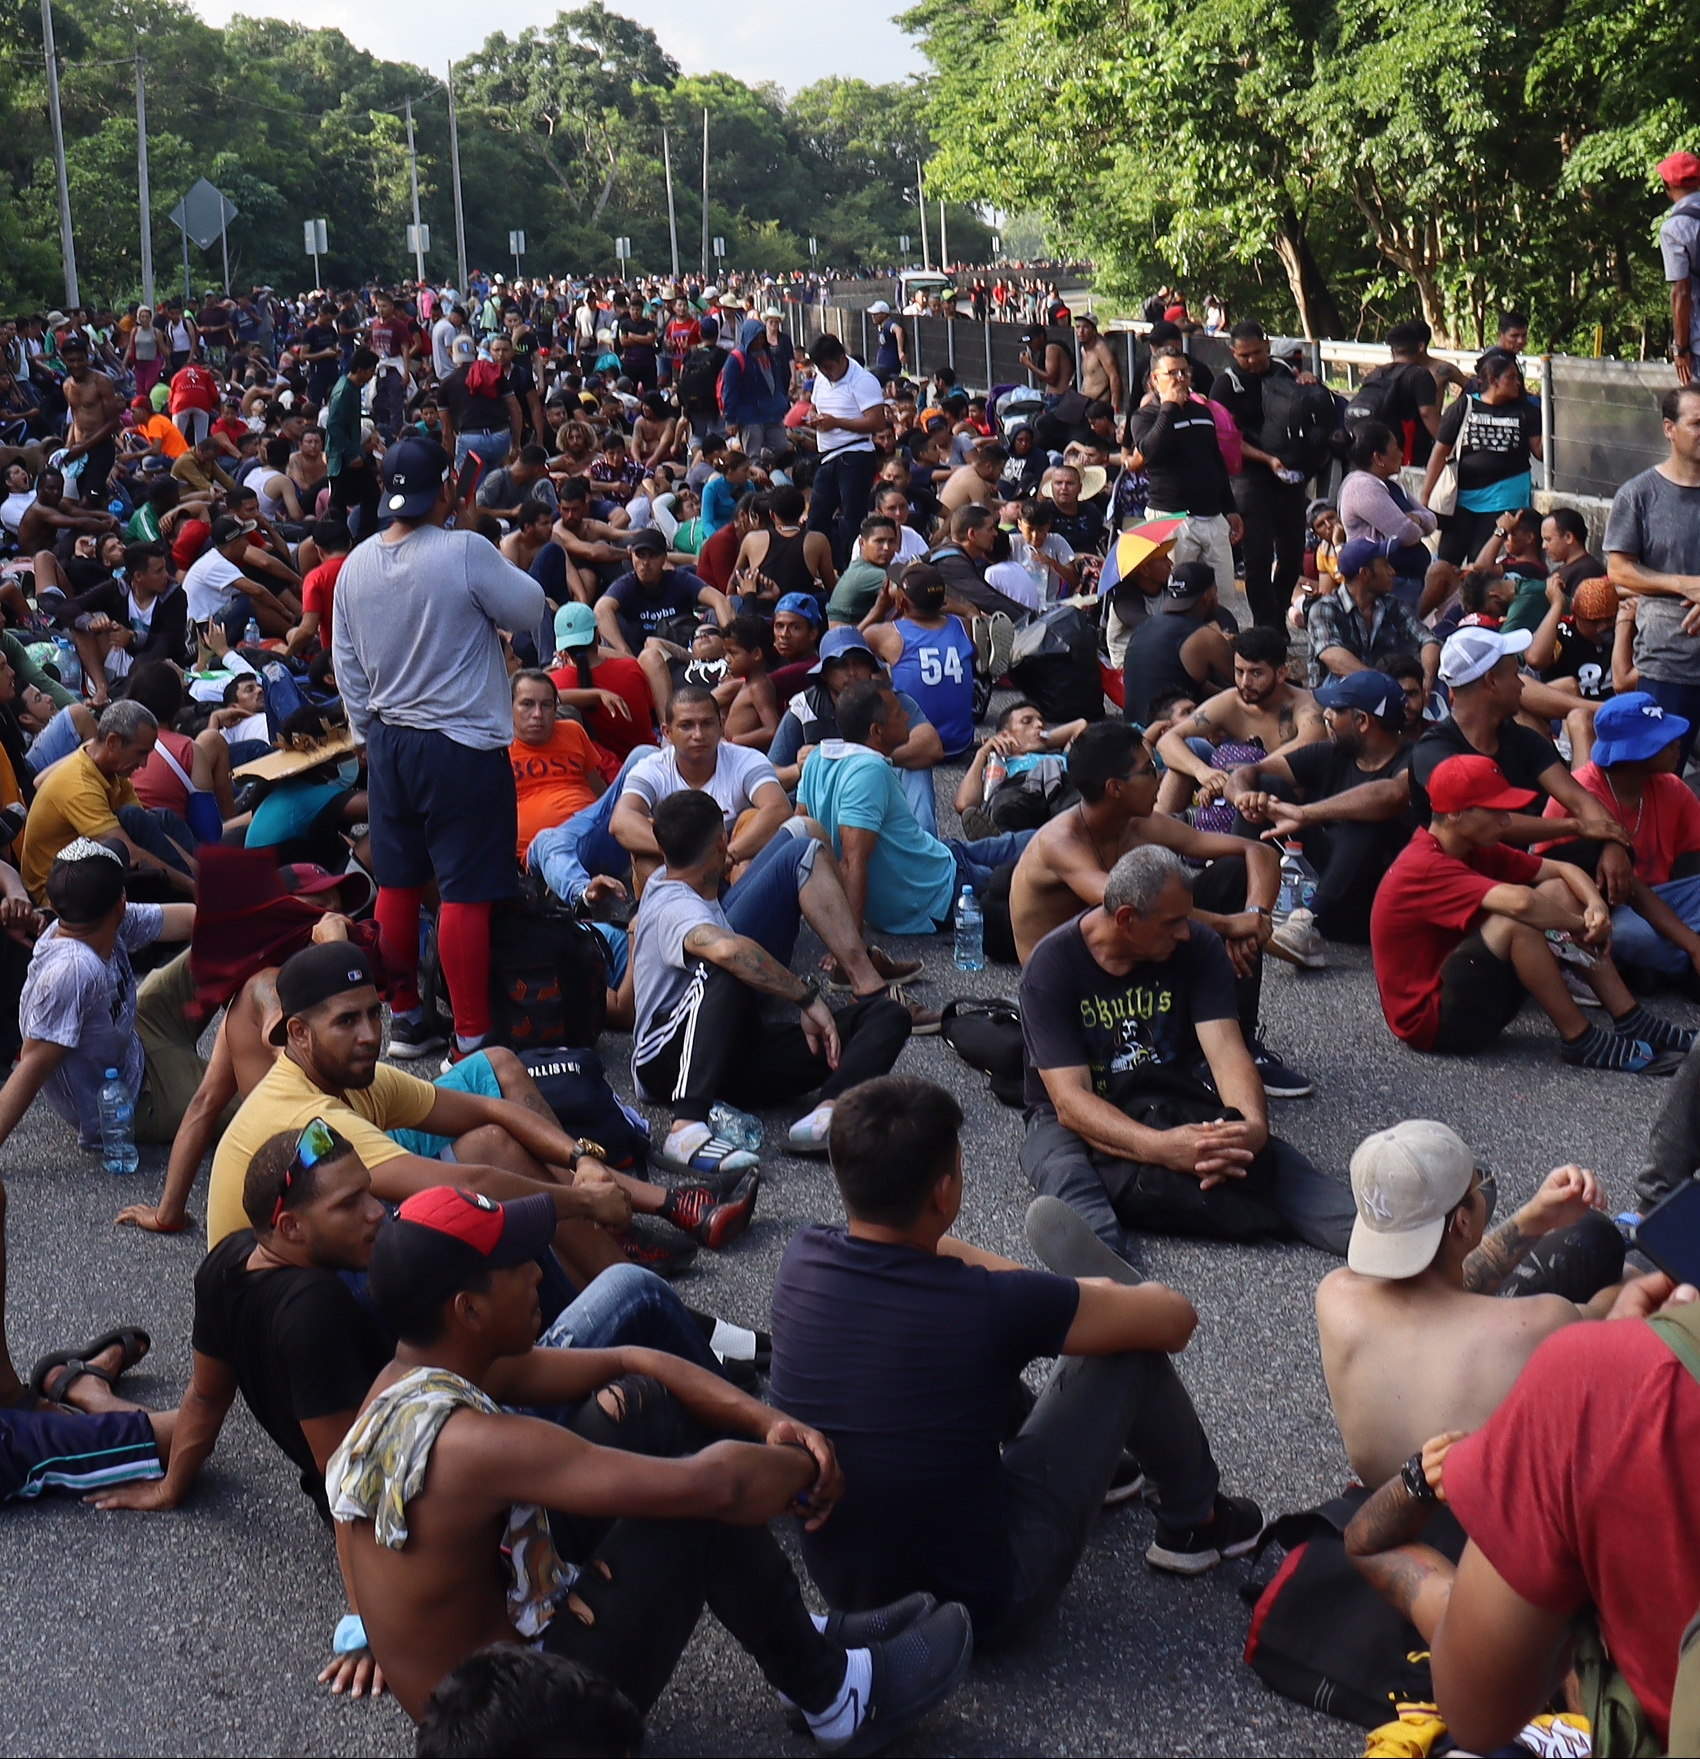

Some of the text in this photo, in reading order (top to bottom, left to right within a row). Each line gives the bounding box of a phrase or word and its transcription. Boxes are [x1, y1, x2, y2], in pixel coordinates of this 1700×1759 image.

[919, 646, 964, 686] 54
[513, 756, 588, 781] BOSS
[527, 1062, 581, 1078] OLLISTER
